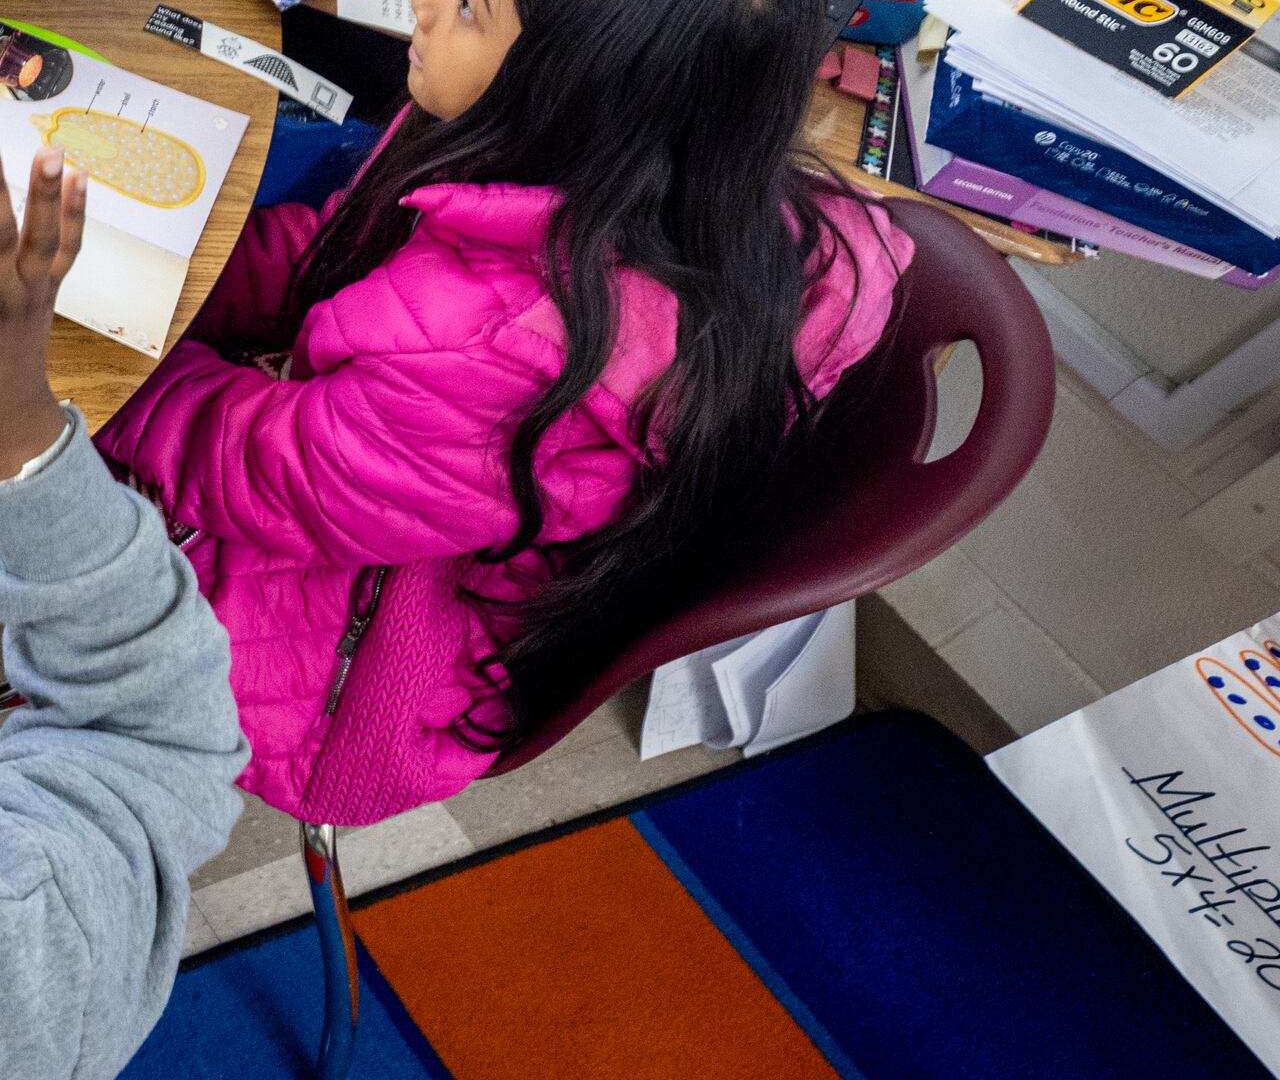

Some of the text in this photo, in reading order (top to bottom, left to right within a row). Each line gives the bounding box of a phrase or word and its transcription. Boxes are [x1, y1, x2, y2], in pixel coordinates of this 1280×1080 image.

[149, 17, 184, 34] reading
[158, 7, 203, 29] What does
[1097, 12, 1120, 32] Stic
[145, 24, 195, 44] sound like?
[1187, 17, 1231, 46] GSM609
[1152, 42, 1198, 71] 60
[1059, 140, 1098, 160] Copy20
[953, 178, 1014, 201] SECOND EDITION
[1106, 223, 1169, 252] Teacher's
[1173, 244, 1223, 267] Manual
